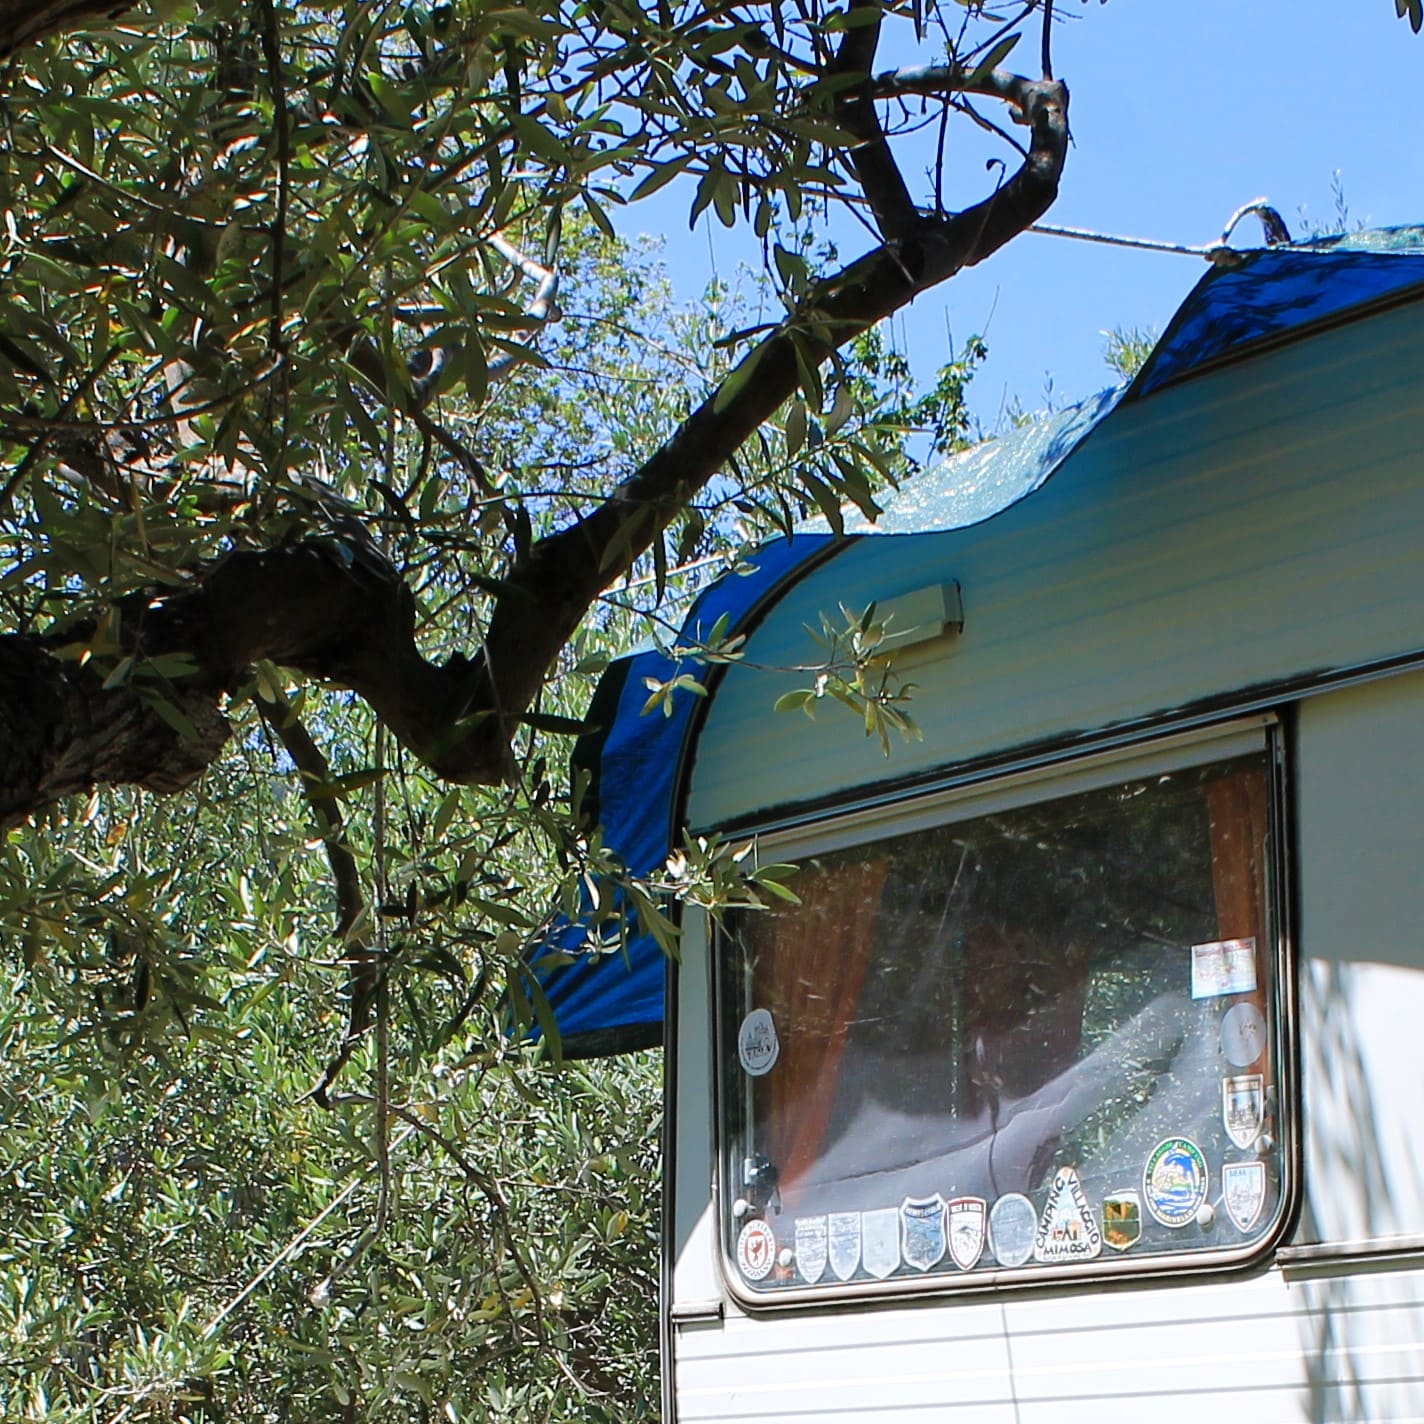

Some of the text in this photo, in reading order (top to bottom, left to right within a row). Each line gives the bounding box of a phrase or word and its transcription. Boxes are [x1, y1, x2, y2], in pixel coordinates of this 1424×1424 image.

[1036, 1177, 1065, 1248] CAMPING
[1067, 1172, 1099, 1245] VILLAGGIO
[1043, 1242, 1092, 1256] MIMOSA
